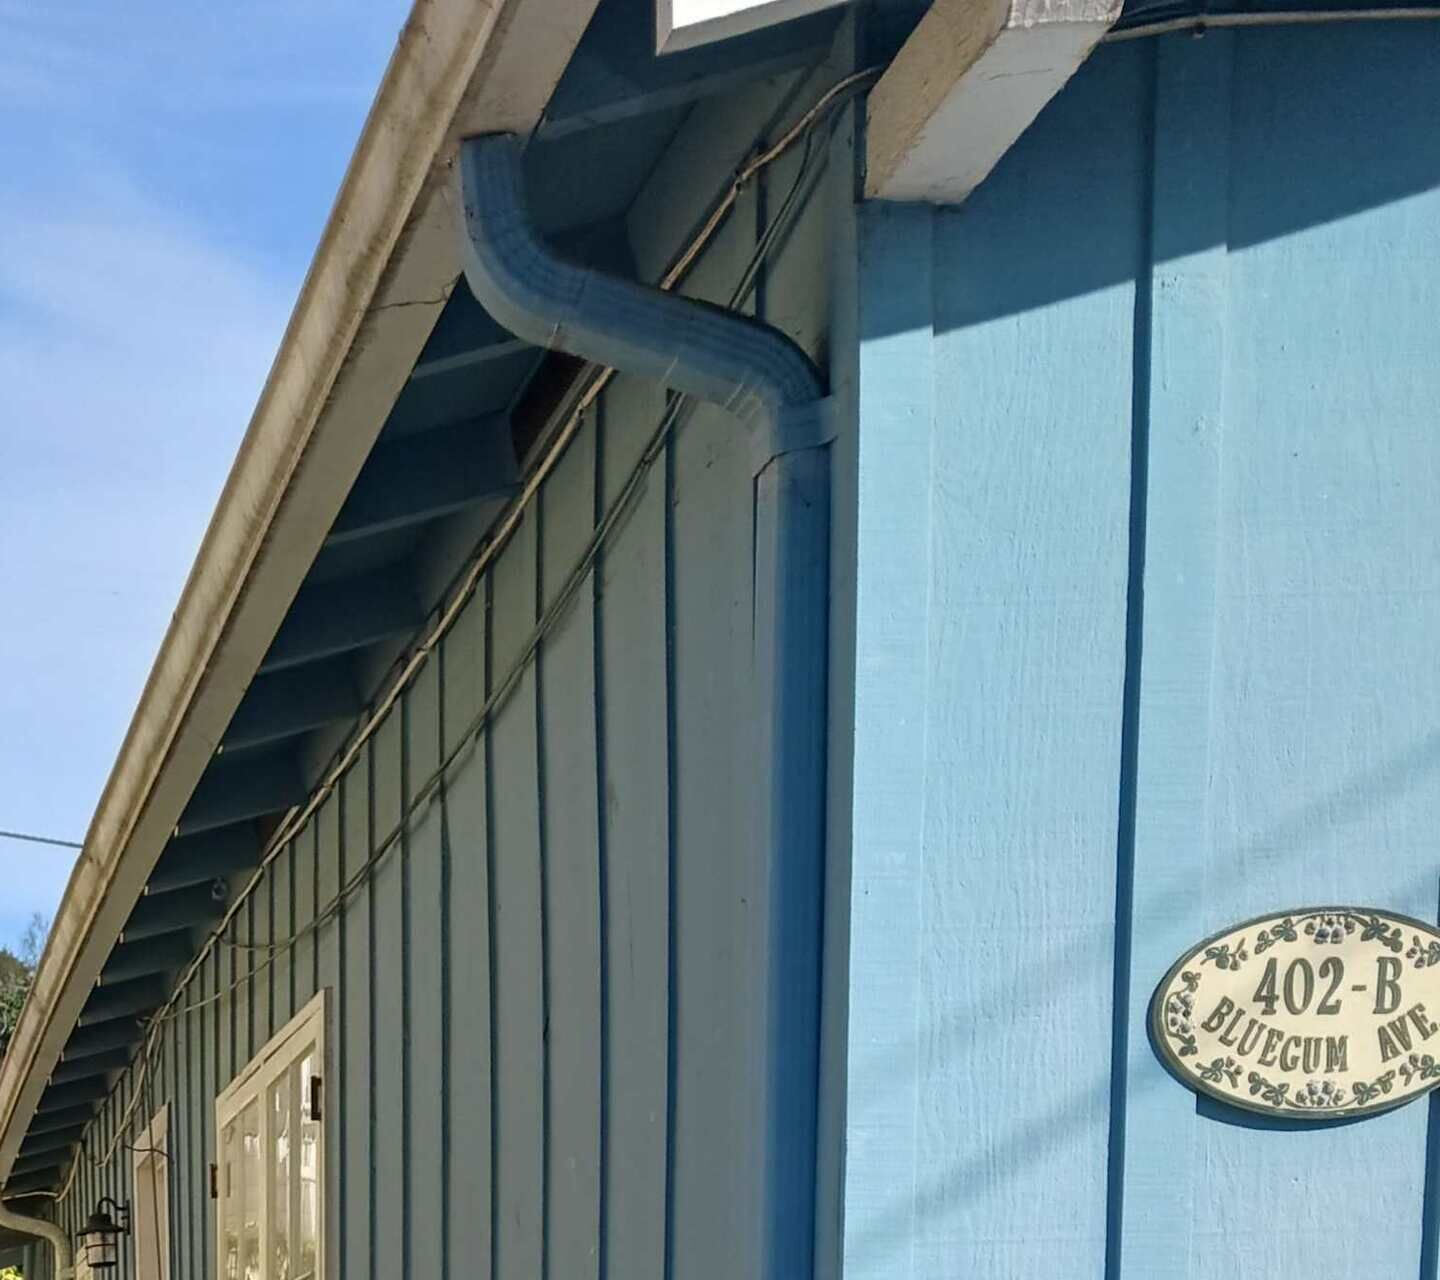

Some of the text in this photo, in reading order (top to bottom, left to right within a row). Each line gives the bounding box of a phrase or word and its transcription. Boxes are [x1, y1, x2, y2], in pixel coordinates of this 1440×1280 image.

[1252, 956, 1403, 1015] 402-B
[1200, 996, 1439, 1074] BLUEGUM AVE
